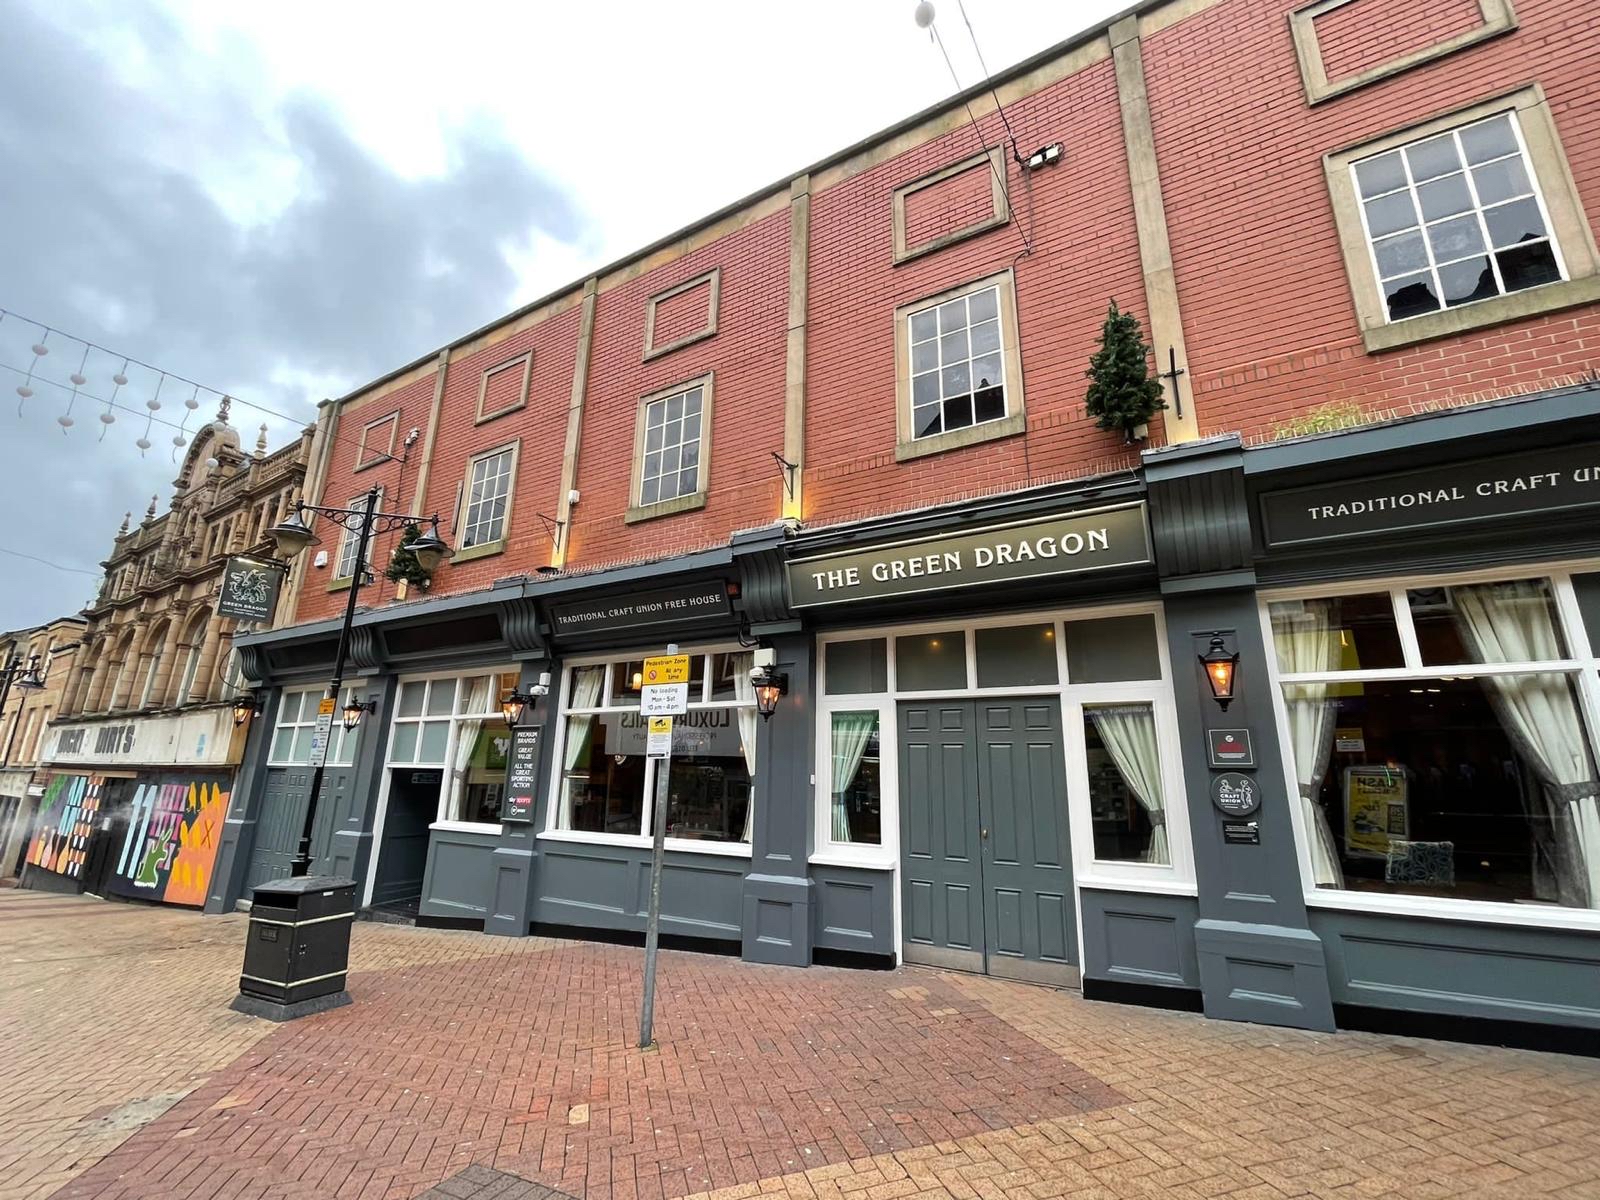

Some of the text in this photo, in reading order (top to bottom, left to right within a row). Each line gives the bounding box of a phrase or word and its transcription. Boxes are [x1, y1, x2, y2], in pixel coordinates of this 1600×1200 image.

[1308, 487, 1465, 520] TRADITIONAL
[1475, 472, 1561, 496] CRAFT
[811, 528, 1110, 591] THE GREEN DRAGON
[558, 594, 722, 624] TRADITIONAL CRAFT UNION FREE HOUSE
